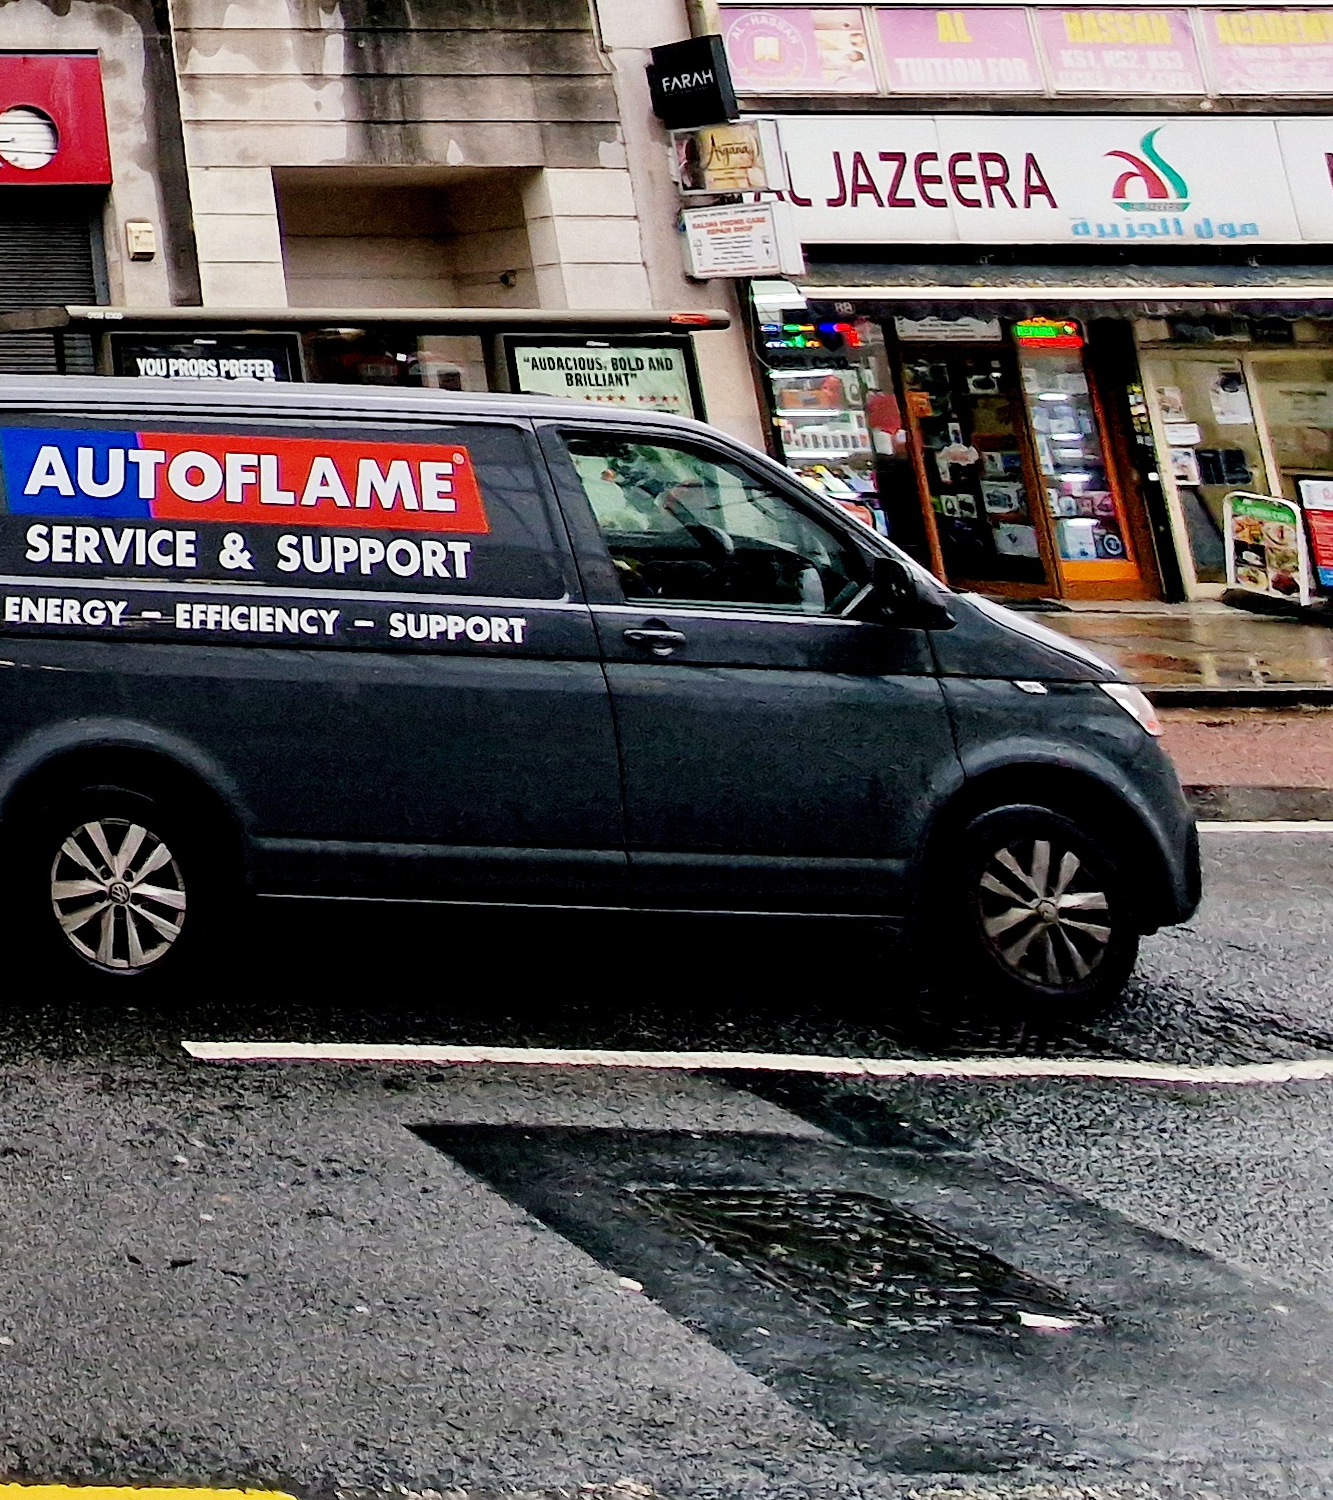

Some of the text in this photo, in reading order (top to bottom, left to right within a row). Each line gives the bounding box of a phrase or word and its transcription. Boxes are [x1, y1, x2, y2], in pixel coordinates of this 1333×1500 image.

[936, 11, 972, 43] AL
[1063, 12, 1173, 45] HASSAN
[661, 68, 715, 93] FARAH
[894, 57, 1031, 85] TUITION FOR
[825, 150, 1060, 209] JAZEERA
[136, 357, 276, 378] YOU PROBS PREFER
[611, 357, 645, 372] BOLD
[648, 357, 674, 372] AND
[23, 444, 458, 513] AUTOFLAME
[24, 524, 472, 580] SERVICE & SUPPORT
[4, 597, 129, 628] ENERGY
[174, 606, 341, 636] EFFICIENCY
[388, 612, 527, 645] SUPPORT
